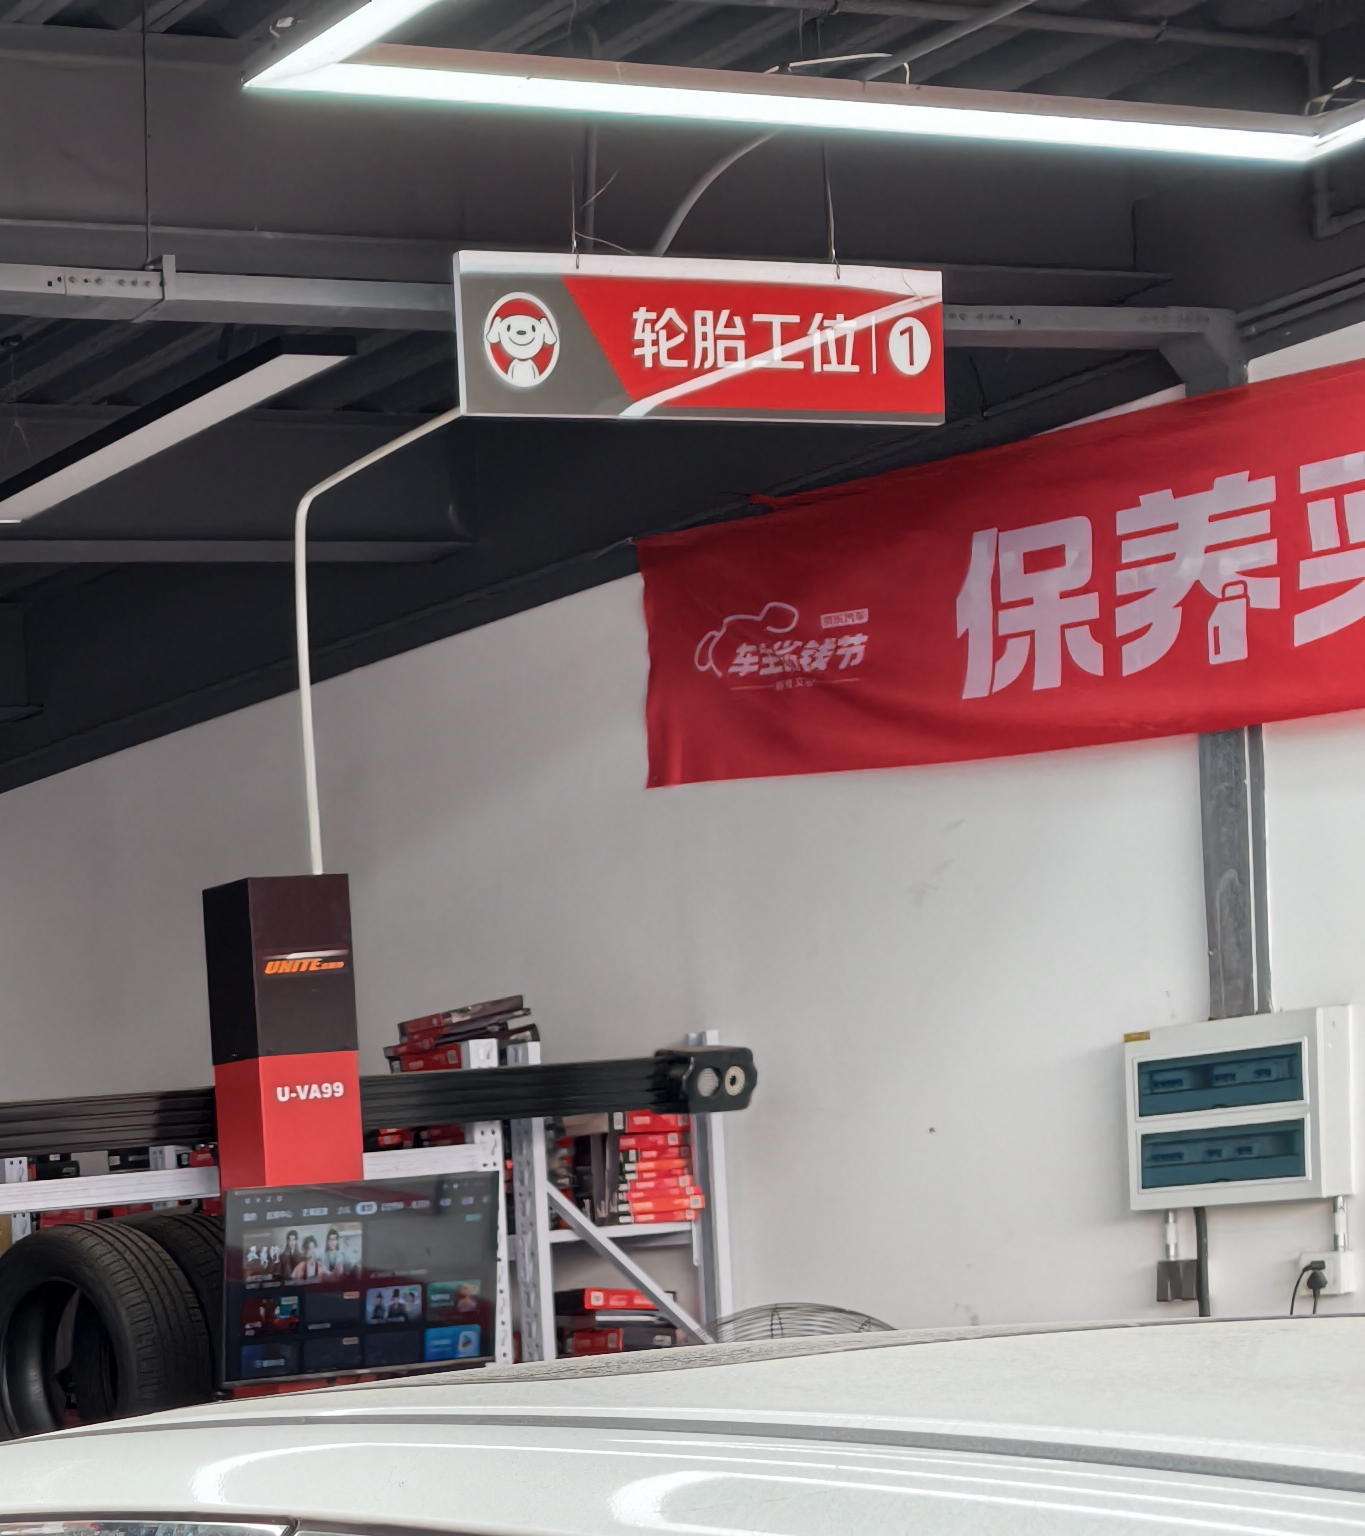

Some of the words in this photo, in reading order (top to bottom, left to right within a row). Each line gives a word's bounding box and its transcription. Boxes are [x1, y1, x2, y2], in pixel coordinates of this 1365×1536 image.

[632, 306, 860, 373] 轮胎工位
[276, 1081, 344, 1102] U-VA99
